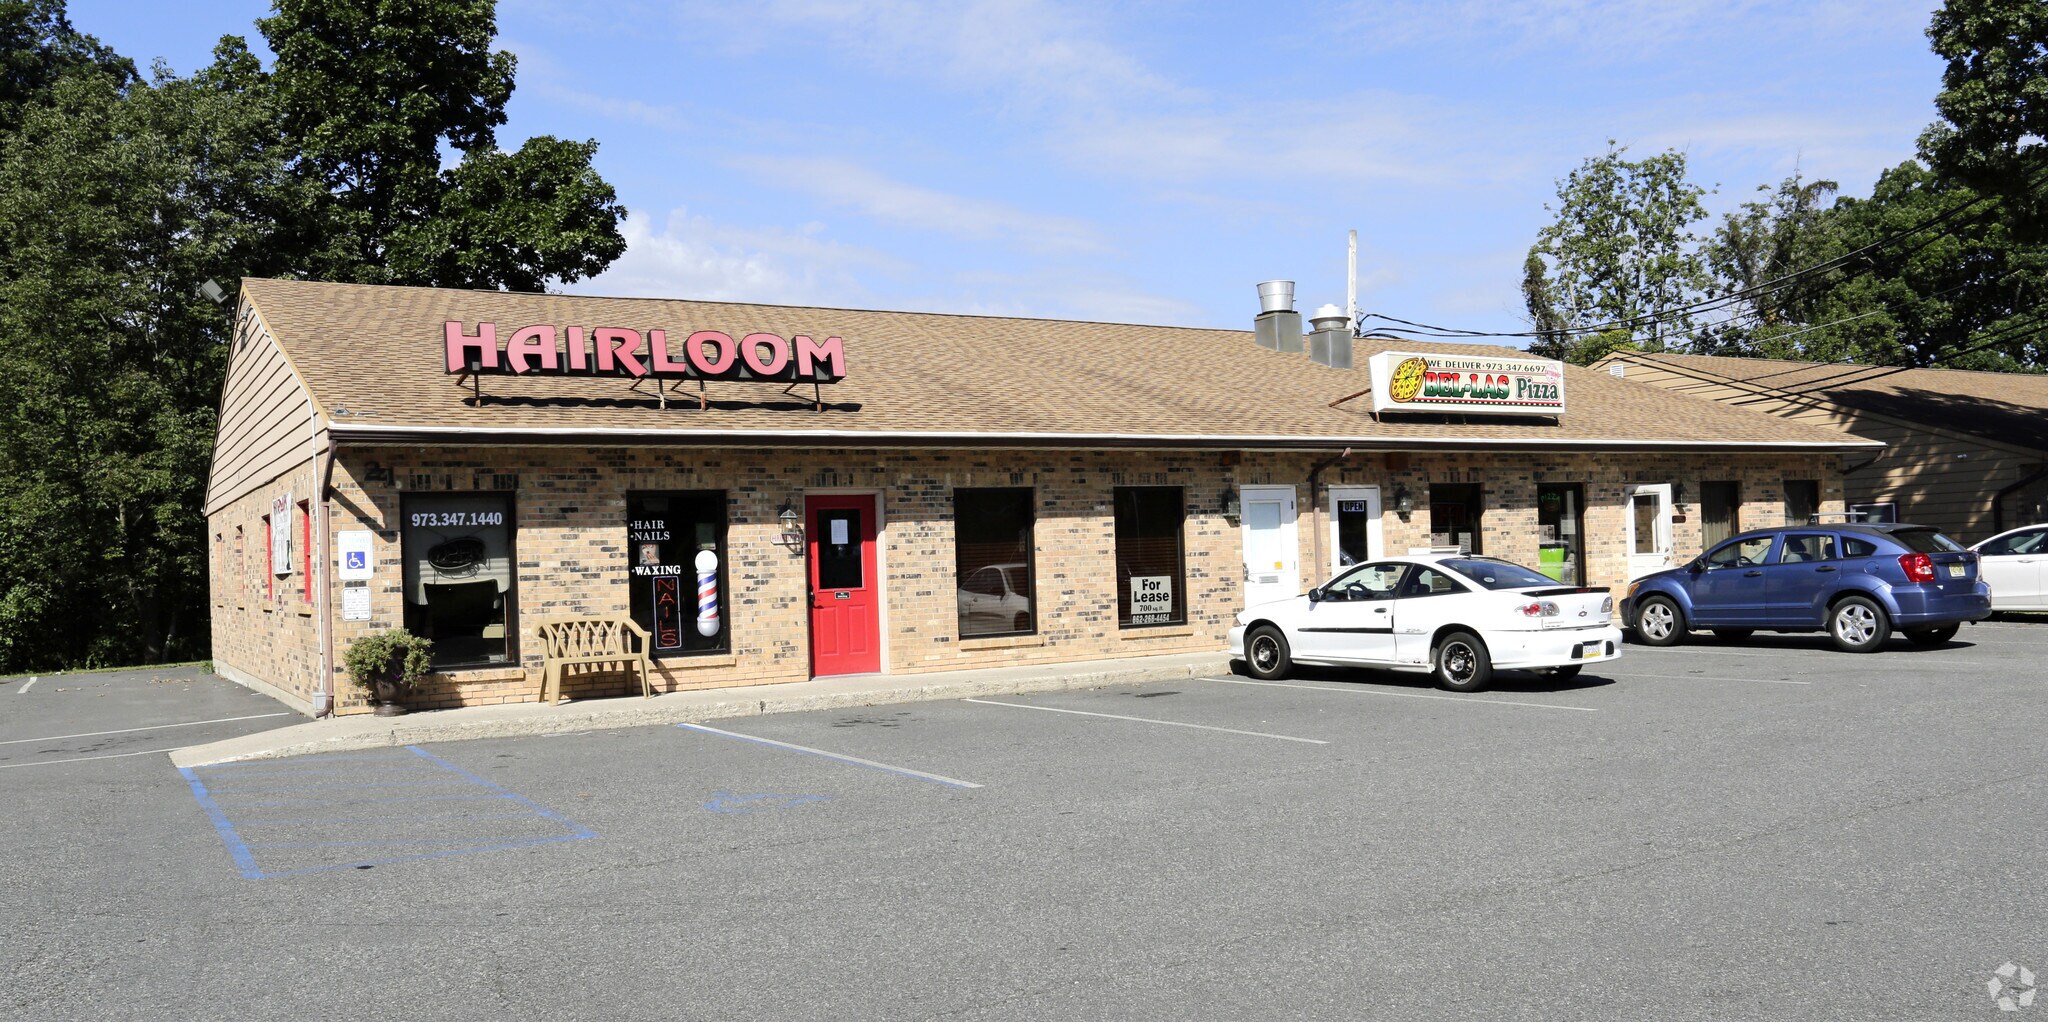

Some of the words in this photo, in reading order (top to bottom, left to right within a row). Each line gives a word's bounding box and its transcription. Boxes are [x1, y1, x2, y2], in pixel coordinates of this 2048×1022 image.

[444, 321, 847, 380] HAIRLOOM
[1428, 360, 1442, 368] WE
[1423, 372, 1510, 399] BEL-LAS
[1516, 376, 1560, 400] Pizza
[1344, 502, 1363, 511] OPEN
[411, 512, 503, 527] 973.347.1440
[634, 520, 665, 530] HAIR
[634, 531, 671, 541] NAILS
[635, 565, 681, 576] WAXING
[1142, 579, 1161, 590] For
[1133, 591, 1169, 602] Lease
[657, 579, 677, 646] NAILS
